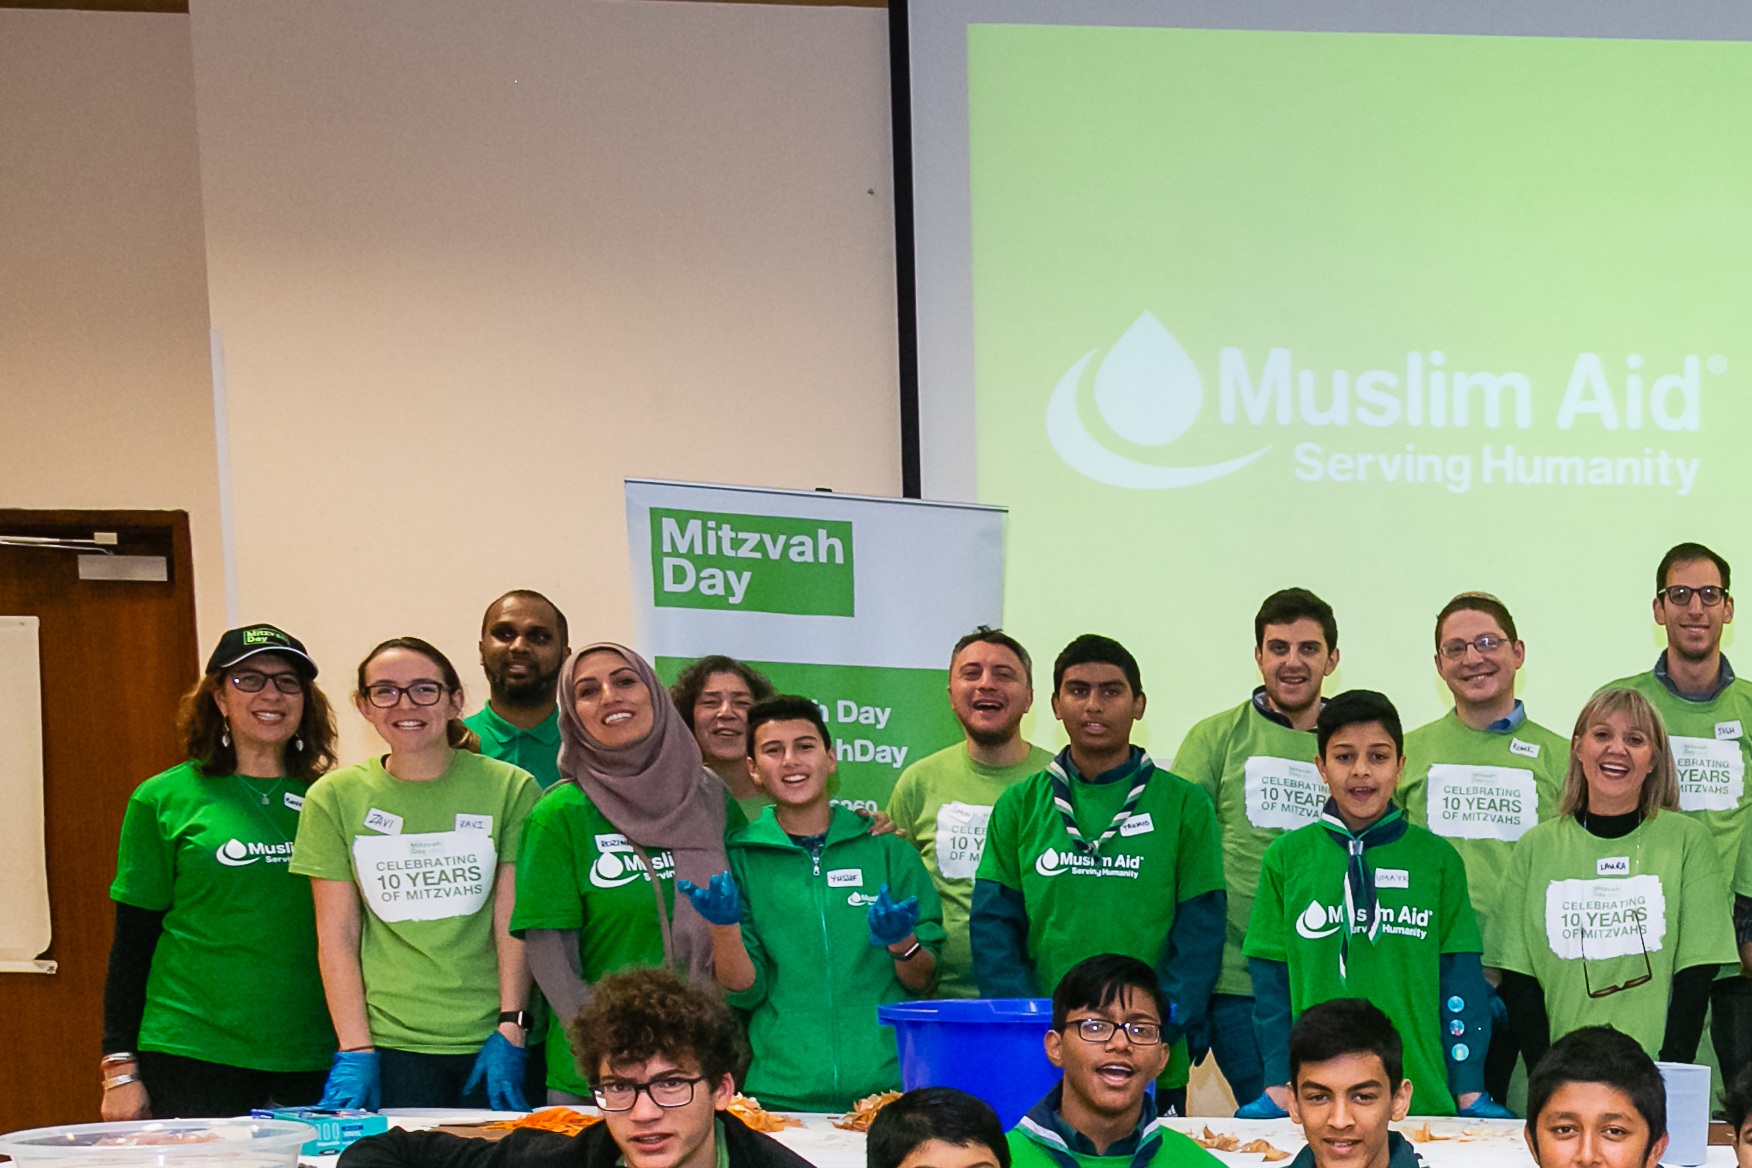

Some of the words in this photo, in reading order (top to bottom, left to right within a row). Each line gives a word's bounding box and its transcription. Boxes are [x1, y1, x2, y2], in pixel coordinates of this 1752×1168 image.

[1218, 346, 1532, 428] Muslim
[1293, 441, 1471, 494] Serving
[1482, 443, 1700, 496] Humanity
[661, 517, 845, 564] Mitzvah
[662, 557, 752, 604] Day
[837, 699, 892, 730] Day
[835, 738, 908, 769] hDay
[1678, 758, 1729, 769] EBRATING
[1677, 769, 1730, 783] YEARS
[1260, 787, 1279, 801] 10
[1284, 789, 1326, 807] YEAR
[1443, 785, 1521, 798] CELEBRATING
[1261, 801, 1277, 811] OF
[1281, 803, 1320, 819] MITZVA
[1442, 796, 1460, 811] 10
[1465, 797, 1522, 813] YEARS
[369, 813, 394, 829] ZAVI
[460, 820, 485, 829] ZAVI
[1442, 811, 1459, 820] OF
[1462, 812, 1521, 826] MITZVAHS
[247, 842, 294, 855] Musli
[950, 836, 968, 850] 10
[376, 854, 477, 872] CELEBRATING
[623, 851, 675, 871] Msli
[950, 850, 965, 861] OF
[1114, 854, 1140, 869] Aid
[377, 873, 400, 890] 10
[406, 866, 481, 887] YEARS
[1102, 868, 1139, 879] Humanity
[381, 891, 400, 902] OF
[406, 884, 483, 900] MITZVAHS
[1562, 896, 1646, 911] CELEBRATING
[1397, 905, 1429, 927] Aid
[1561, 913, 1580, 927] 10
[1586, 907, 1648, 928] YEARS
[1382, 924, 1428, 940] Humanity
[1562, 928, 1580, 940] OF
[1583, 924, 1648, 939] MITZVAHS
